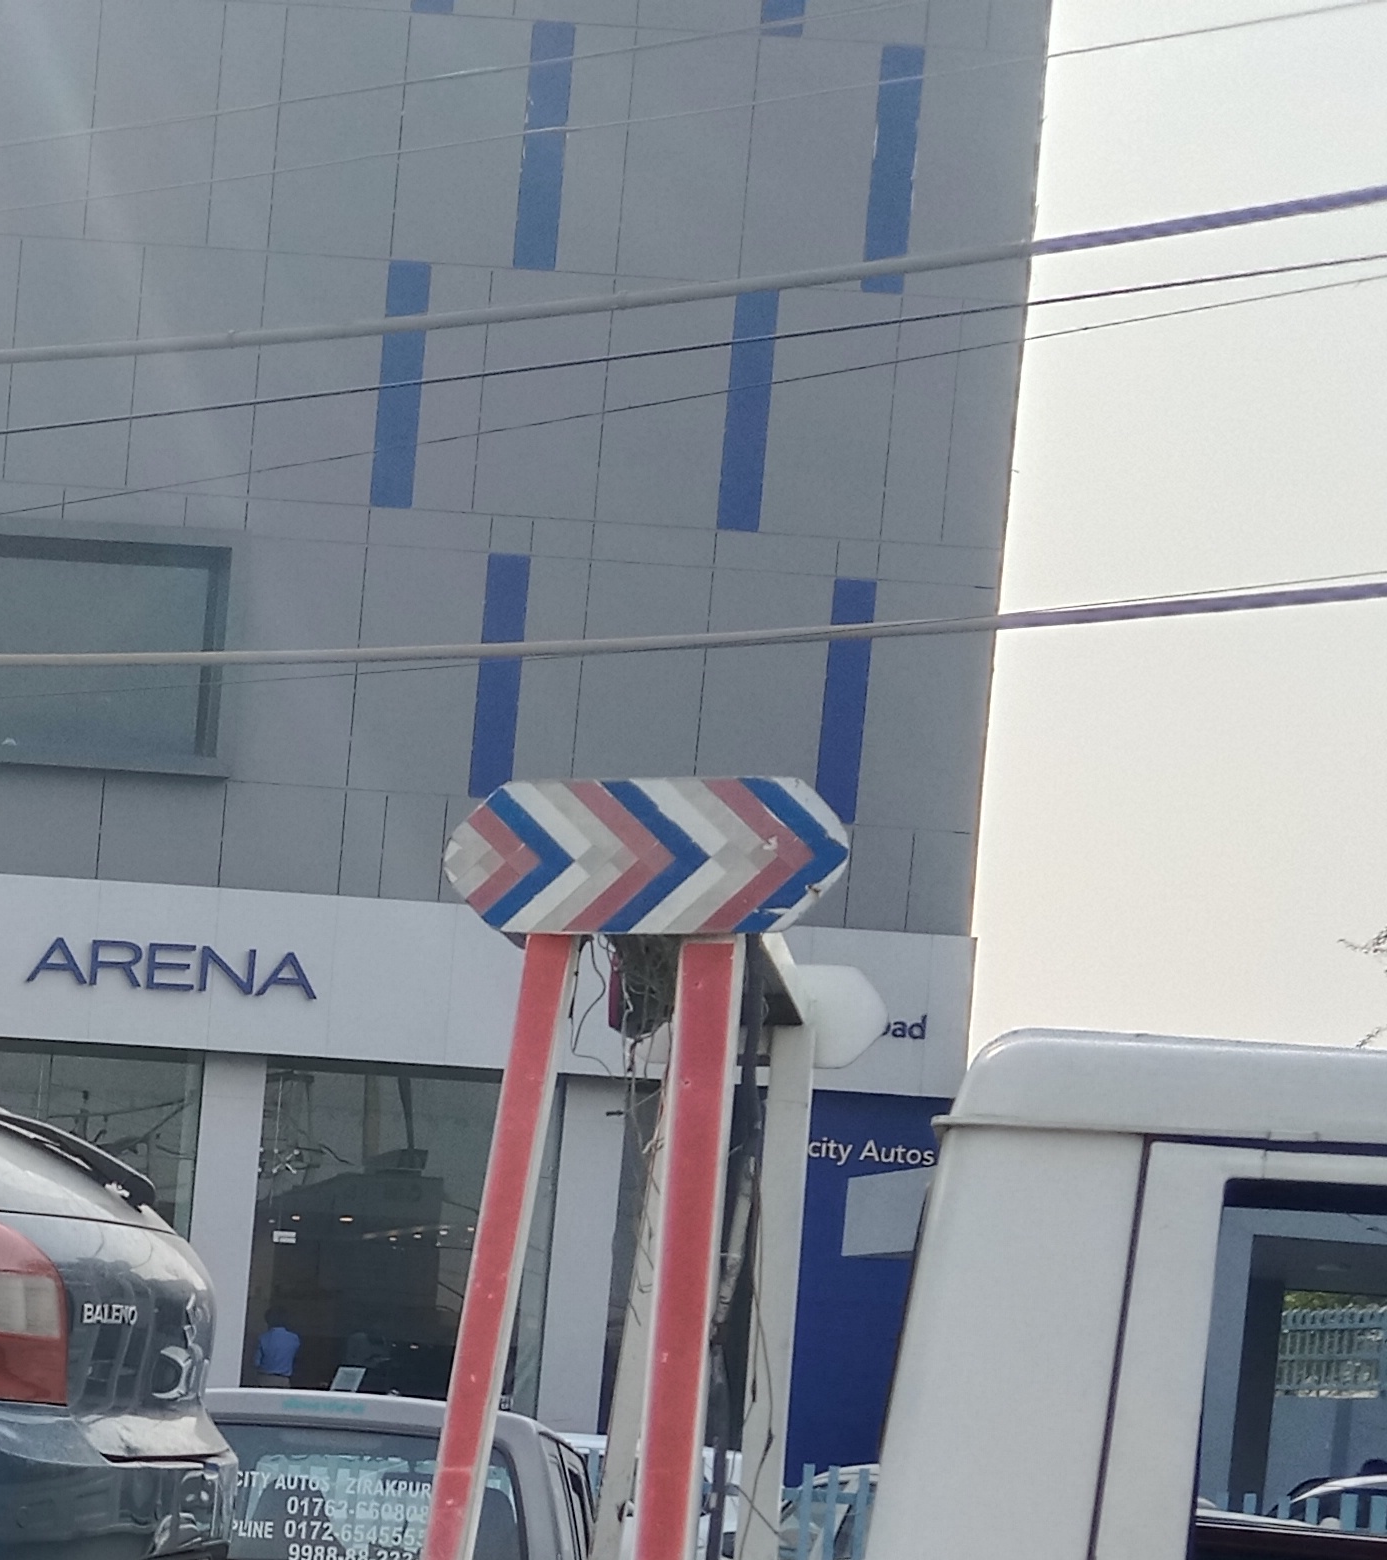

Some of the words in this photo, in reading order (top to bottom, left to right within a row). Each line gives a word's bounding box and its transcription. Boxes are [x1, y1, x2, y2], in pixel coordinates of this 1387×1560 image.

[26, 937, 317, 999] ARENA
[882, 1014, 927, 1040] ad
[859, 1139, 935, 1166] Autos
[82, 1302, 138, 1325] BALENO
[274, 1473, 331, 1493] AUTOS
[345, 1477, 432, 1500] ZIRAKPUR
